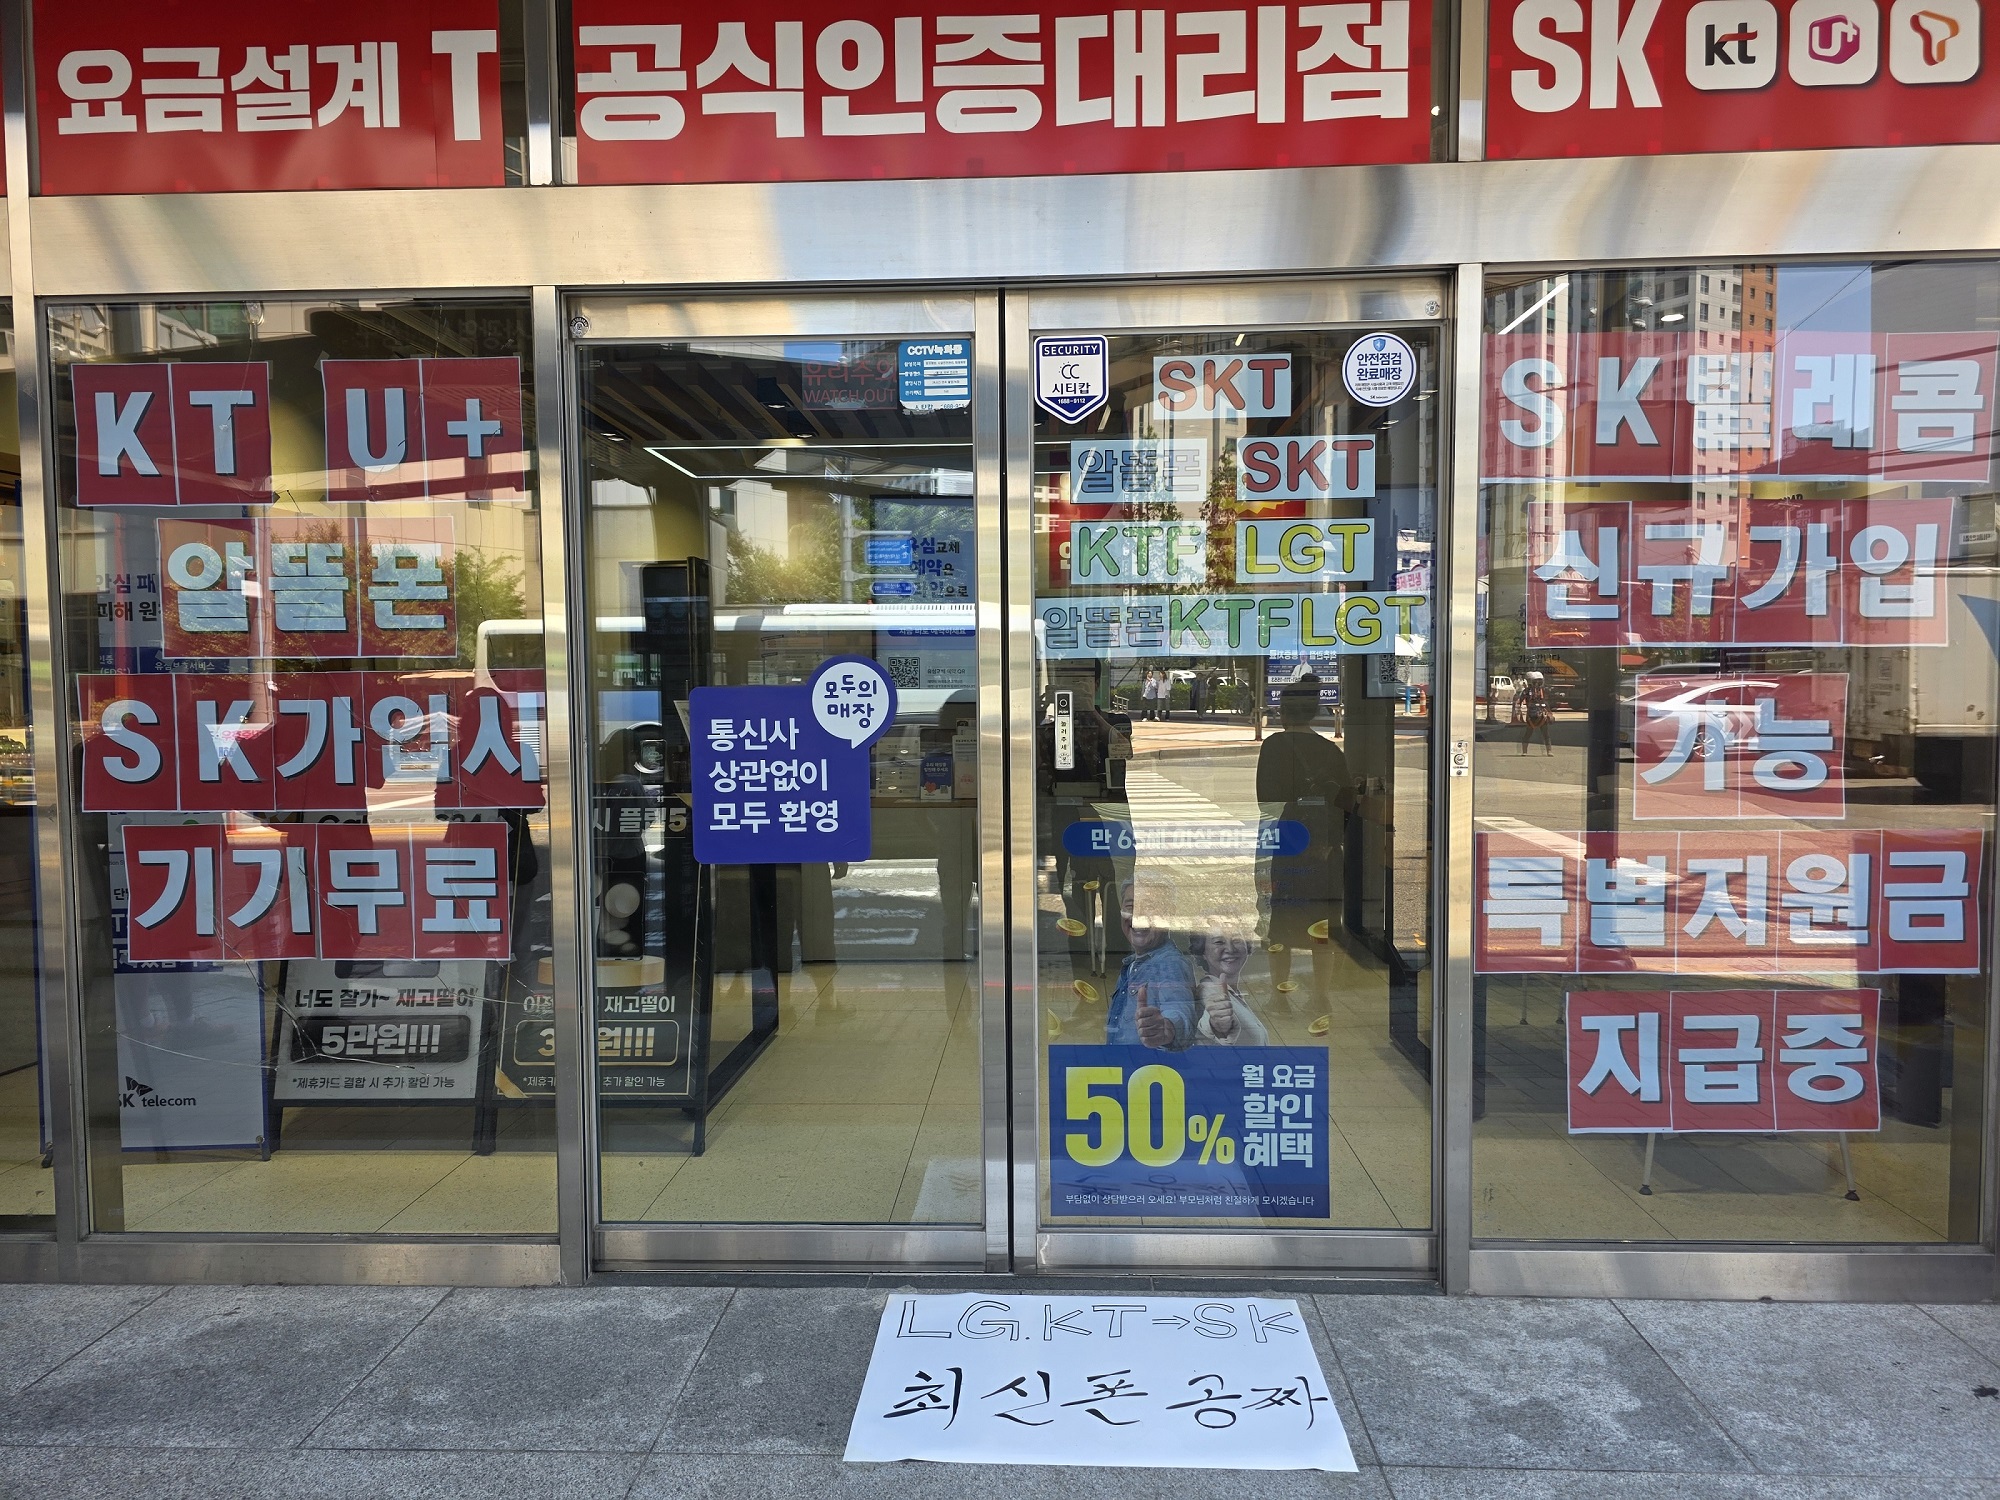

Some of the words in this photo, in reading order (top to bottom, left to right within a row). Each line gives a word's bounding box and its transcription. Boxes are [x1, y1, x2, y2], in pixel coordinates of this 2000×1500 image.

[577, 1, 1409, 141] 공식인증대리점
[1510, 0, 1662, 113] SK
[1704, 21, 1758, 66] kt
[57, 41, 401, 135] 요금설계
[431, 29, 497, 142] T
[1044, 345, 1098, 356] SECURITY
[1357, 352, 1402, 366] 안전점검
[803, 359, 897, 386] 유리주의
[1052, 382, 1091, 395] 시티캅
[1157, 358, 1291, 412] SKT
[1356, 367, 1402, 381] 완료매장
[803, 389, 859, 403] WATCH
[864, 388, 897, 403] OUT
[1500, 352, 1984, 453] SK텔레콤
[95, 390, 254, 477] KT
[345, 387, 502, 474] U+
[1078, 449, 1201, 493] 알뜰폰
[1241, 439, 1374, 493] SKT
[1078, 524, 1202, 578] KTF
[1245, 523, 1370, 574] LGT
[167, 541, 448, 633] 알뜰폰
[1532, 523, 1940, 621] 신규가입
[138, 601, 161, 622] 원
[824, 674, 877, 699] 모두의
[827, 703, 875, 729] 매장
[706, 717, 800, 752] 통신사
[1638, 697, 1836, 792] 가능
[708, 758, 828, 793] 상관없이
[709, 800, 771, 834] 모두
[778, 800, 839, 834] 환영
[1091, 828, 1110, 850] 만
[134, 846, 502, 938] 기기무료
[1483, 849, 1970, 947] 특별지원금
[604, 995, 675, 1013] 재고떨이
[321, 1023, 441, 1056] 5만원!!!
[1577, 1011, 1869, 1104] 지급중
[343, 1076, 366, 1090] 결합
[369, 1076, 380, 1090] 시
[382, 1076, 405, 1090] 추가
[407, 1076, 431, 1090] 할인
[432, 1076, 456, 1090] 가능
[602, 1076, 623, 1088] 추가
[624, 1076, 645, 1088] 할인
[646, 1076, 666, 1088] 가능
[1241, 1064, 1265, 1088] 월
[1271, 1064, 1316, 1089] 요금
[141, 1094, 197, 1108] telecom
[1065, 1063, 1235, 1167] 50%
[1243, 1092, 1313, 1130] 할인
[1243, 1132, 1314, 1168] 혜택
[1065, 1194, 1100, 1206] 부담없이
[1102, 1194, 1146, 1206] 상담받으러
[1147, 1194, 1177, 1206] 오세요!
[1179, 1194, 1222, 1206] 부모님처럼
[1224, 1195, 1260, 1206] 친절하게
[1261, 1195, 1315, 1207] 모시겠습니다
[1192, 1303, 1300, 1343] SK
[1165, 1369, 1329, 1431] 공짜
